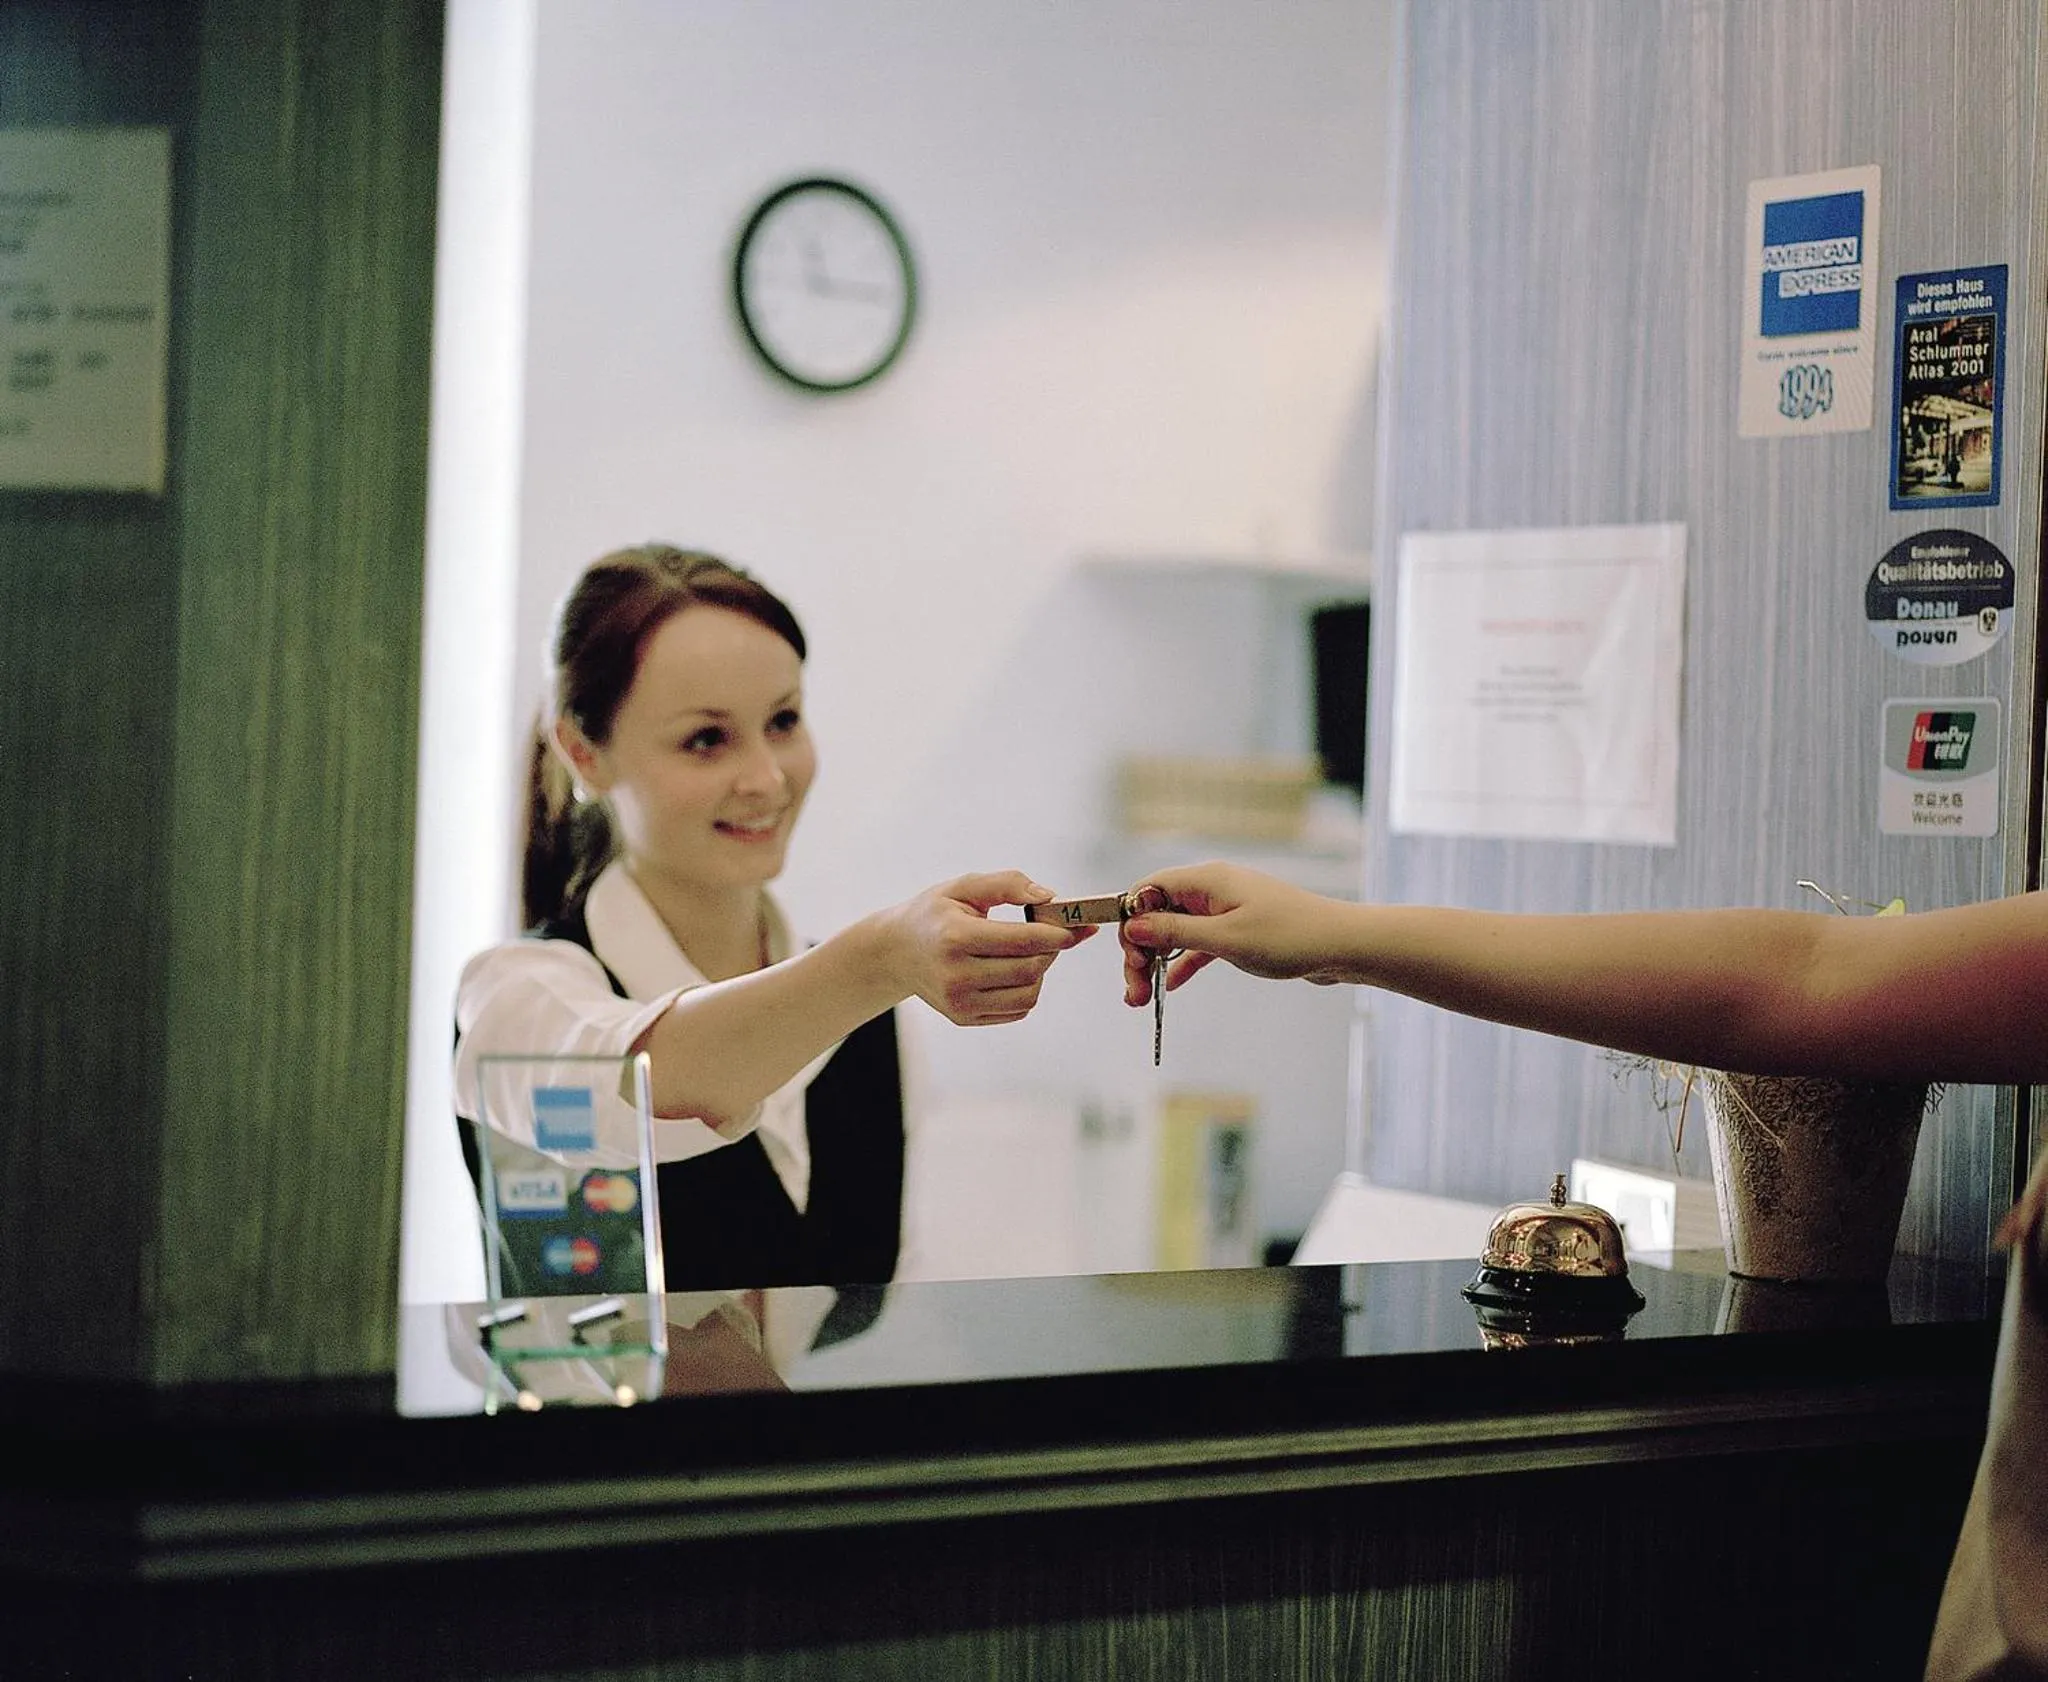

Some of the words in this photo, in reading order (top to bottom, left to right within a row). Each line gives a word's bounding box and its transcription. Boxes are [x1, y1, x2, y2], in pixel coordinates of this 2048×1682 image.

[1764, 241, 1855, 267] AMERICAN
[1781, 269, 1860, 294] EXPRESS
[1917, 282, 1953, 298] Dieses
[1956, 279, 1984, 294] Haus
[1908, 299, 1932, 315] wird
[1934, 294, 1993, 314] empfohlen
[1910, 325, 1938, 344] Aral
[1909, 342, 1989, 362] Schlummer
[1908, 363, 1945, 380] Atlas
[1950, 358, 1984, 376] 2001
[1878, 560, 2004, 585] Qualitätsbetrieb
[1897, 597, 1958, 619] Donau
[1914, 725, 1970, 746] UnionPay
[1912, 810, 1963, 826] Welcome
[1061, 905, 1083, 923] 14
